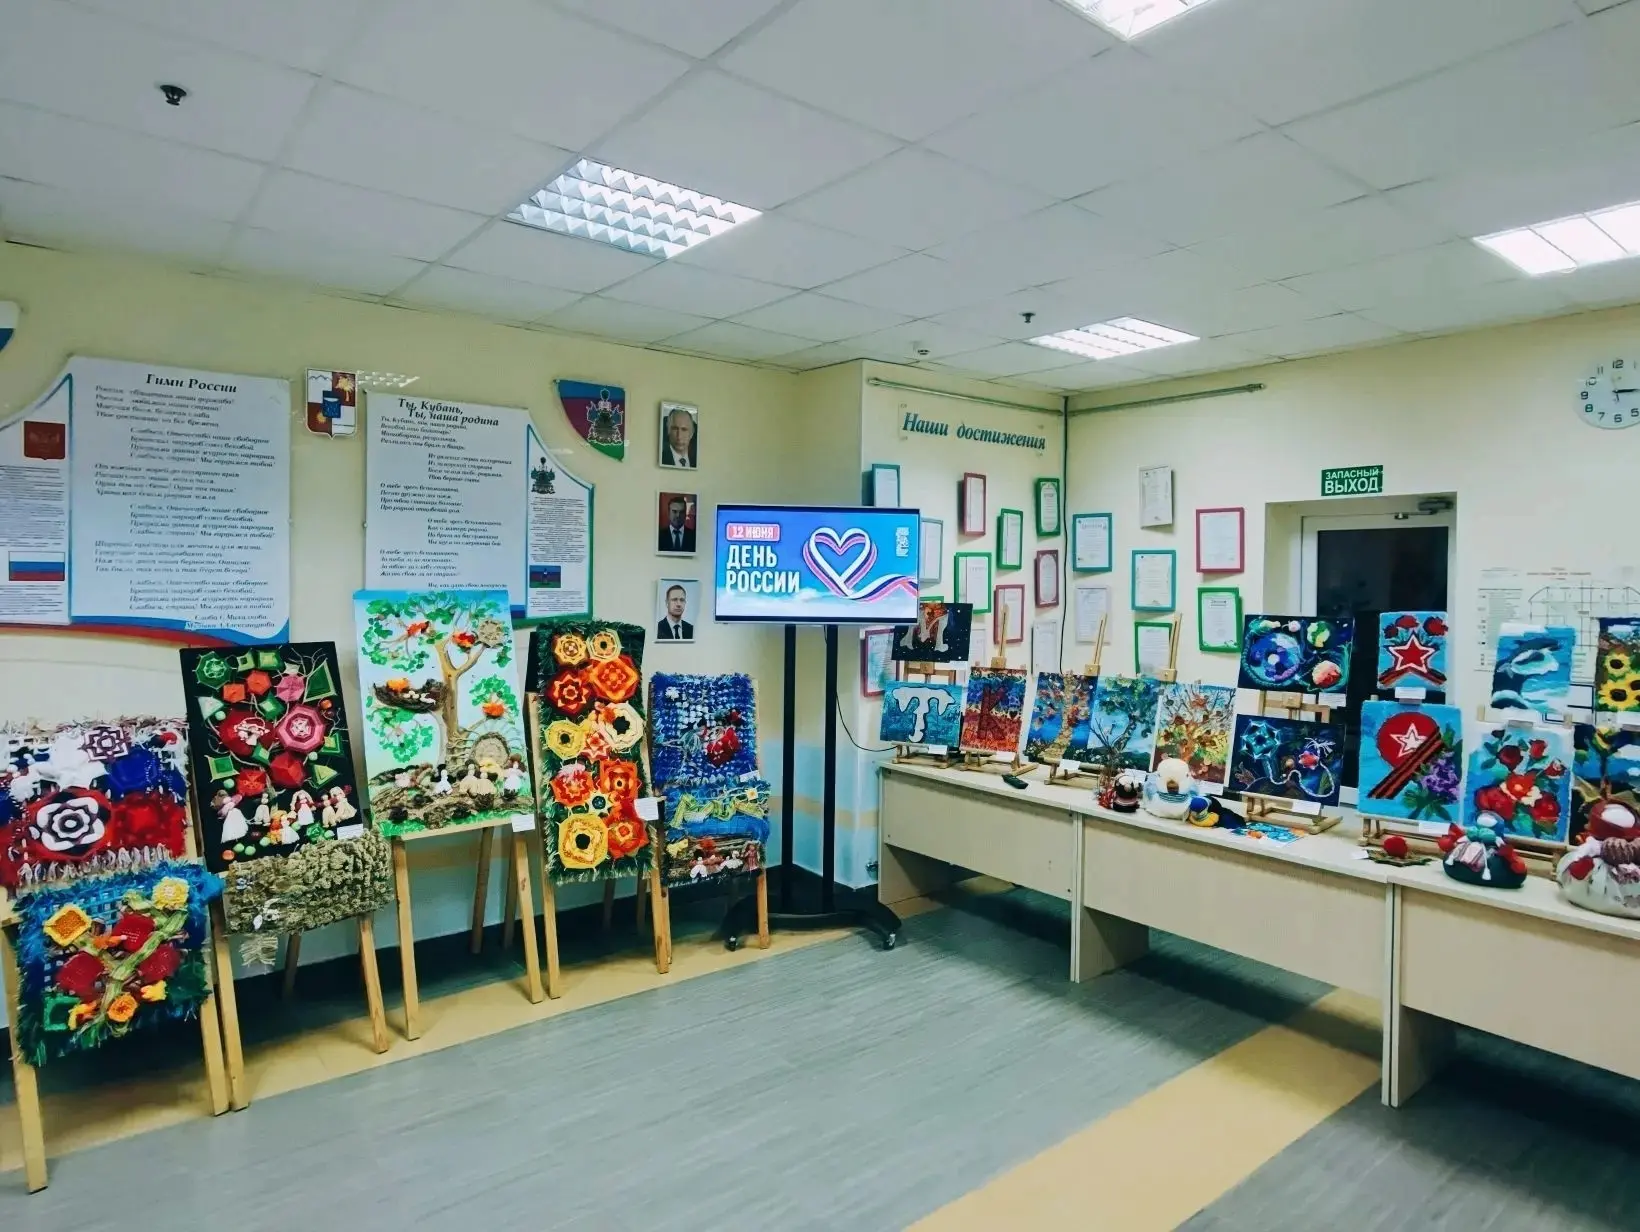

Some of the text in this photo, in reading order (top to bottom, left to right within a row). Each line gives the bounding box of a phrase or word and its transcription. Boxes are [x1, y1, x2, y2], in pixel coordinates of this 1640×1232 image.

[1612, 360, 1624, 368] 12
[146, 374, 184, 388] Гимн
[188, 378, 236, 393] России
[1581, 392, 1588, 400] 9
[398, 398, 464, 415] Ты, Кубань,
[1585, 404, 1593, 412] 8
[1630, 408, 1639, 417] 5
[408, 409, 499, 426] Ты, наша родина
[1598, 412, 1605, 420] 7
[1614, 414, 1622, 422] 6
[902, 412, 1046, 450] Наши достижения
[1326, 467, 1378, 480] ЗАПАСНЫЙ
[1325, 477, 1378, 494] ВЫХОД
[732, 526, 774, 538] 12 ИЮНЯ
[726, 545, 777, 570] ДЕНЬ
[726, 570, 800, 593] РОССИИ
